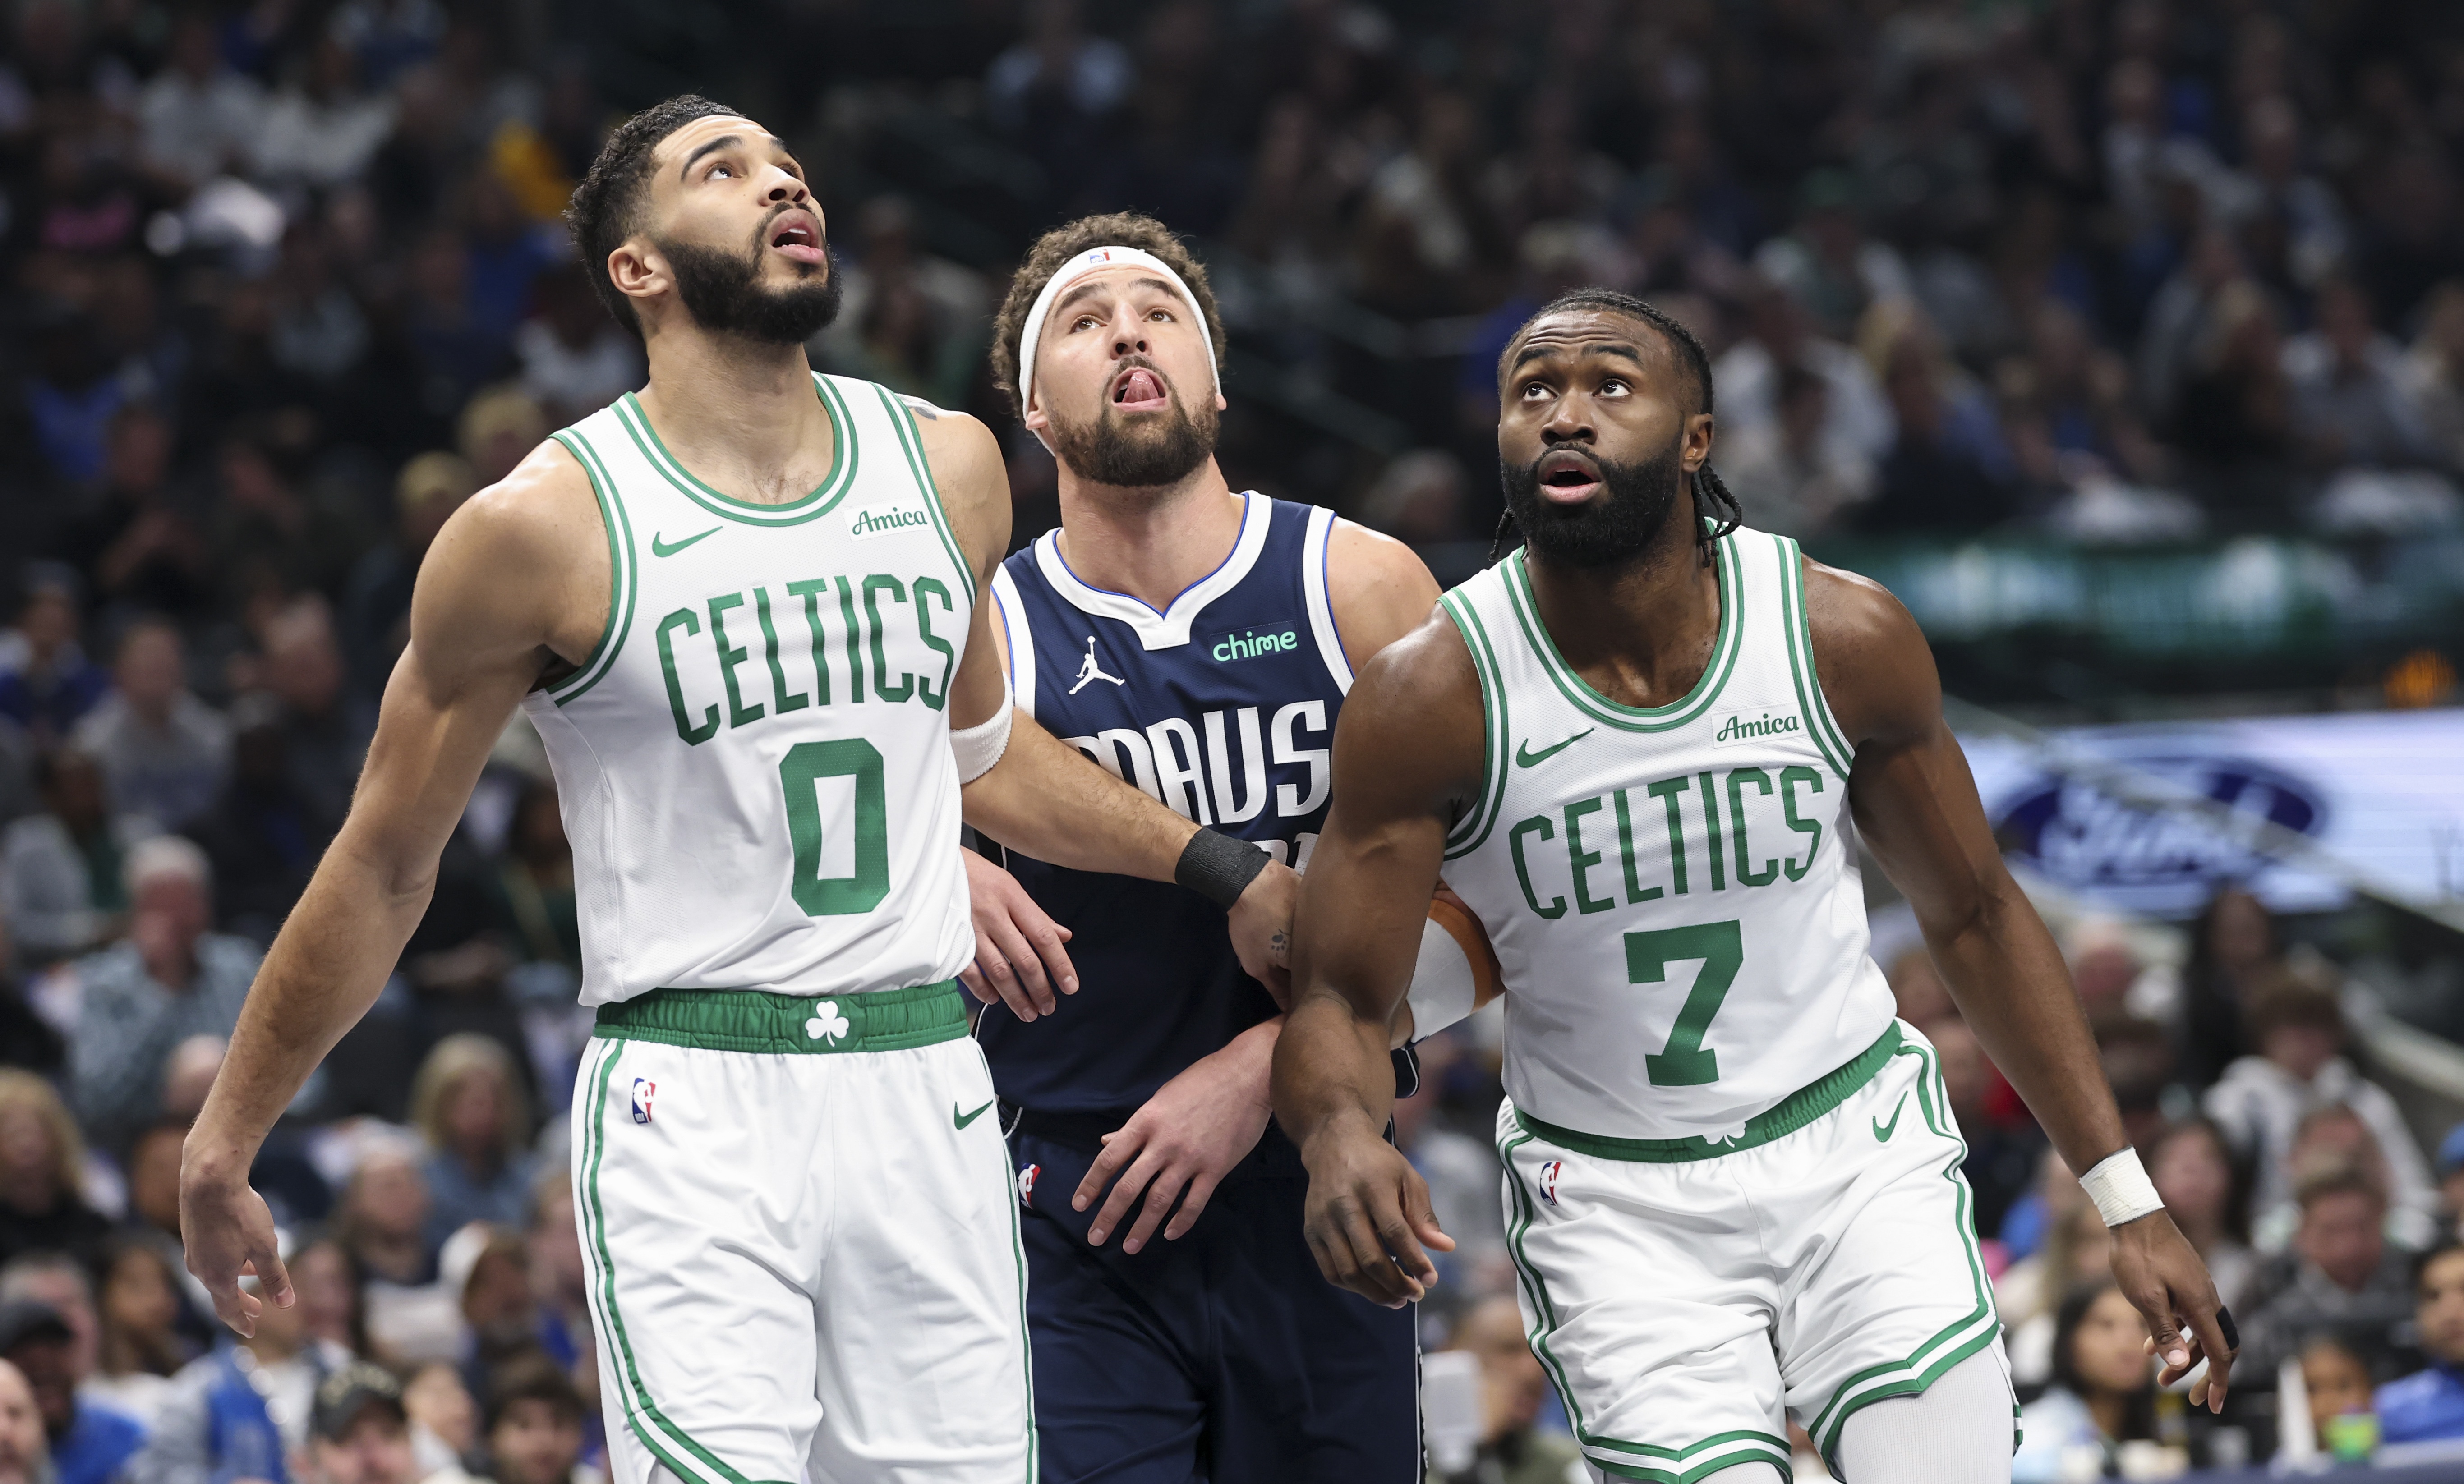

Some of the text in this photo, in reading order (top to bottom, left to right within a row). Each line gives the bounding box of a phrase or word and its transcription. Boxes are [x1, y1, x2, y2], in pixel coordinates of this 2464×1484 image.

[852, 507, 928, 535] Amica
[656, 574, 954, 746] CELTICS
[1213, 631, 1298, 662] chime
[1717, 714, 1799, 742] Amica
[779, 738, 890, 917] 0
[1509, 765, 1824, 919] CELTICS
[1624, 919, 1744, 1086] 7
